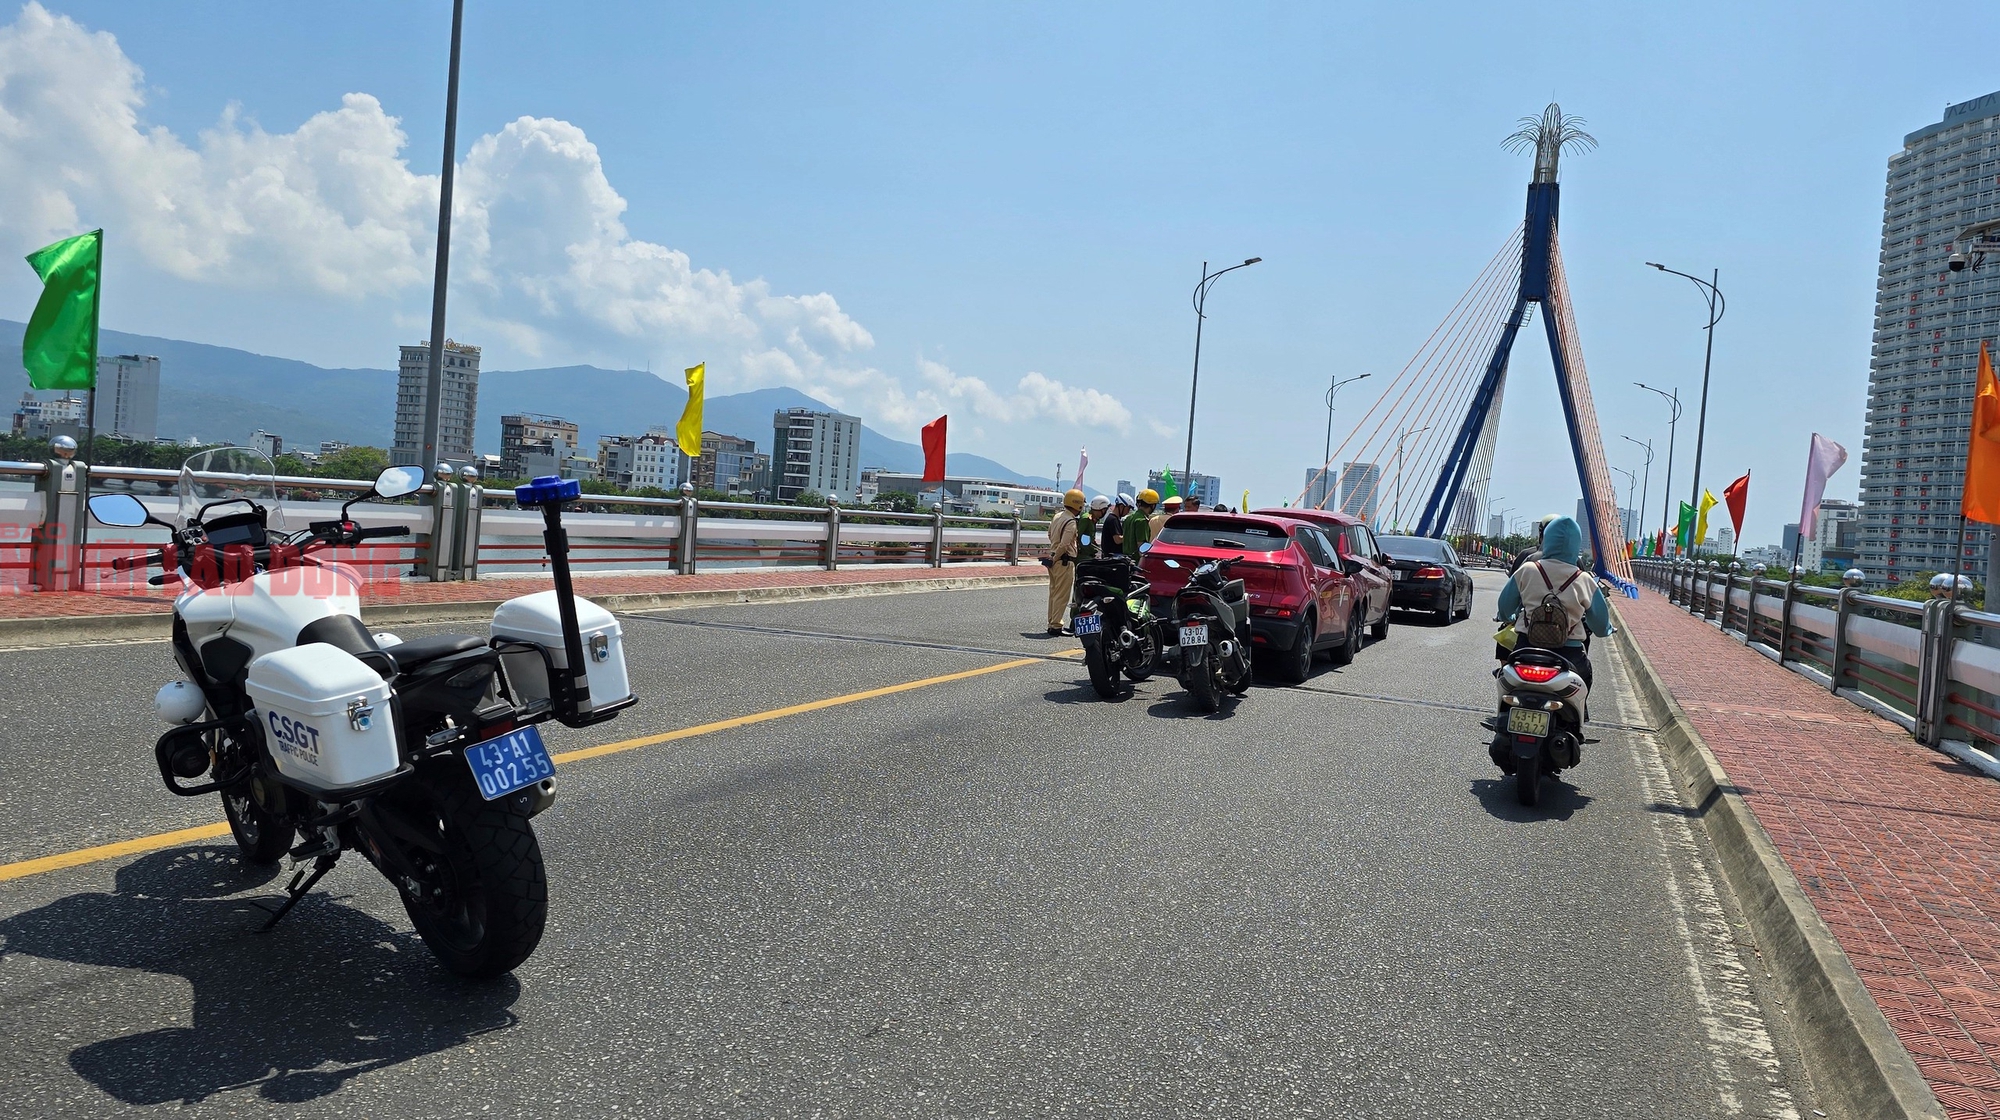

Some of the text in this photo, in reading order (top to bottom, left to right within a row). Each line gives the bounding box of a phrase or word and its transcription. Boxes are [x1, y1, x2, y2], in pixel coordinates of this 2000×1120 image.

[1515, 711, 1542, 723] 43-F1
[278, 740, 319, 766] TRAFFIC POLICE
[479, 732, 532, 768] 43-A1
[481, 752, 550, 795] 002.55
